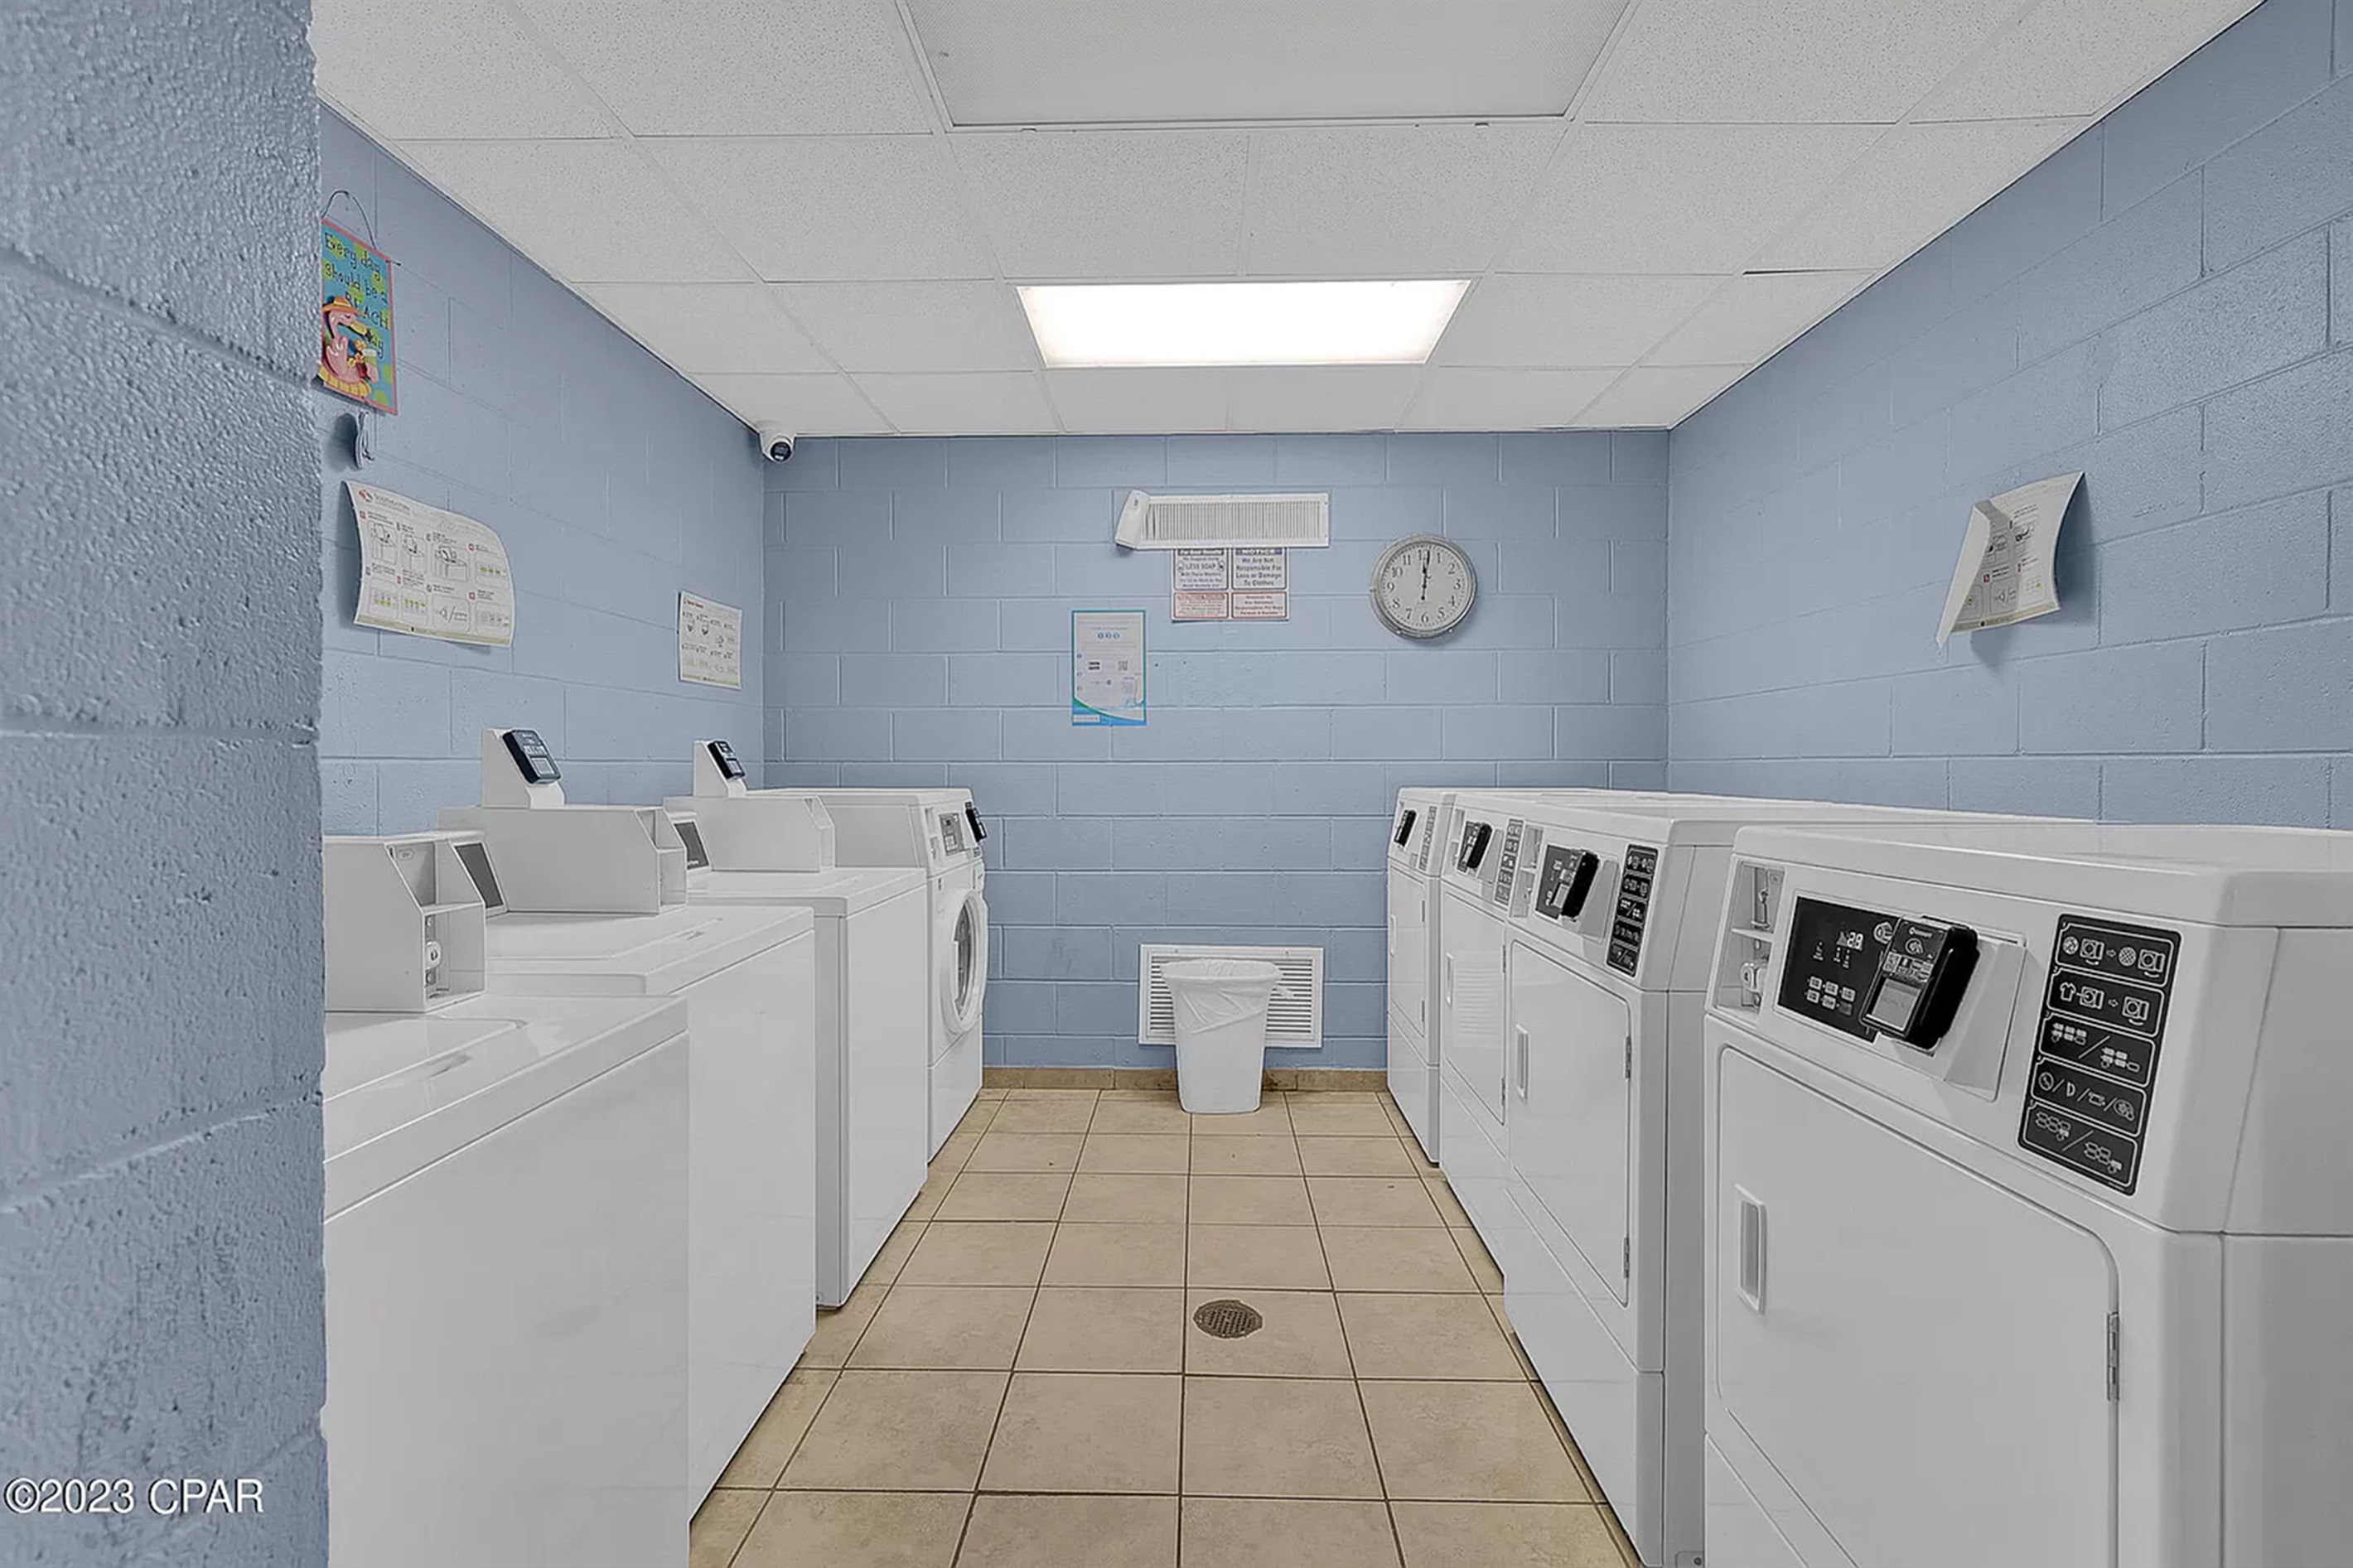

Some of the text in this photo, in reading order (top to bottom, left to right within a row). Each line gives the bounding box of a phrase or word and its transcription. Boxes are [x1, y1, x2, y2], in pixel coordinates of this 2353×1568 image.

[324, 232, 381, 282] Every day
[365, 278, 378, 299] be
[1392, 567, 1404, 577] 10
[1447, 563, 1456, 574] 2
[1259, 572, 1282, 580] Damage
[1387, 582, 1395, 593] 9
[1453, 579, 1461, 590] 3
[1392, 598, 1400, 609] 8
[1448, 596, 1456, 606] 4
[1405, 608, 1412, 620] 7
[1421, 614, 1429, 623] 6
[1437, 607, 1445, 620] 5
